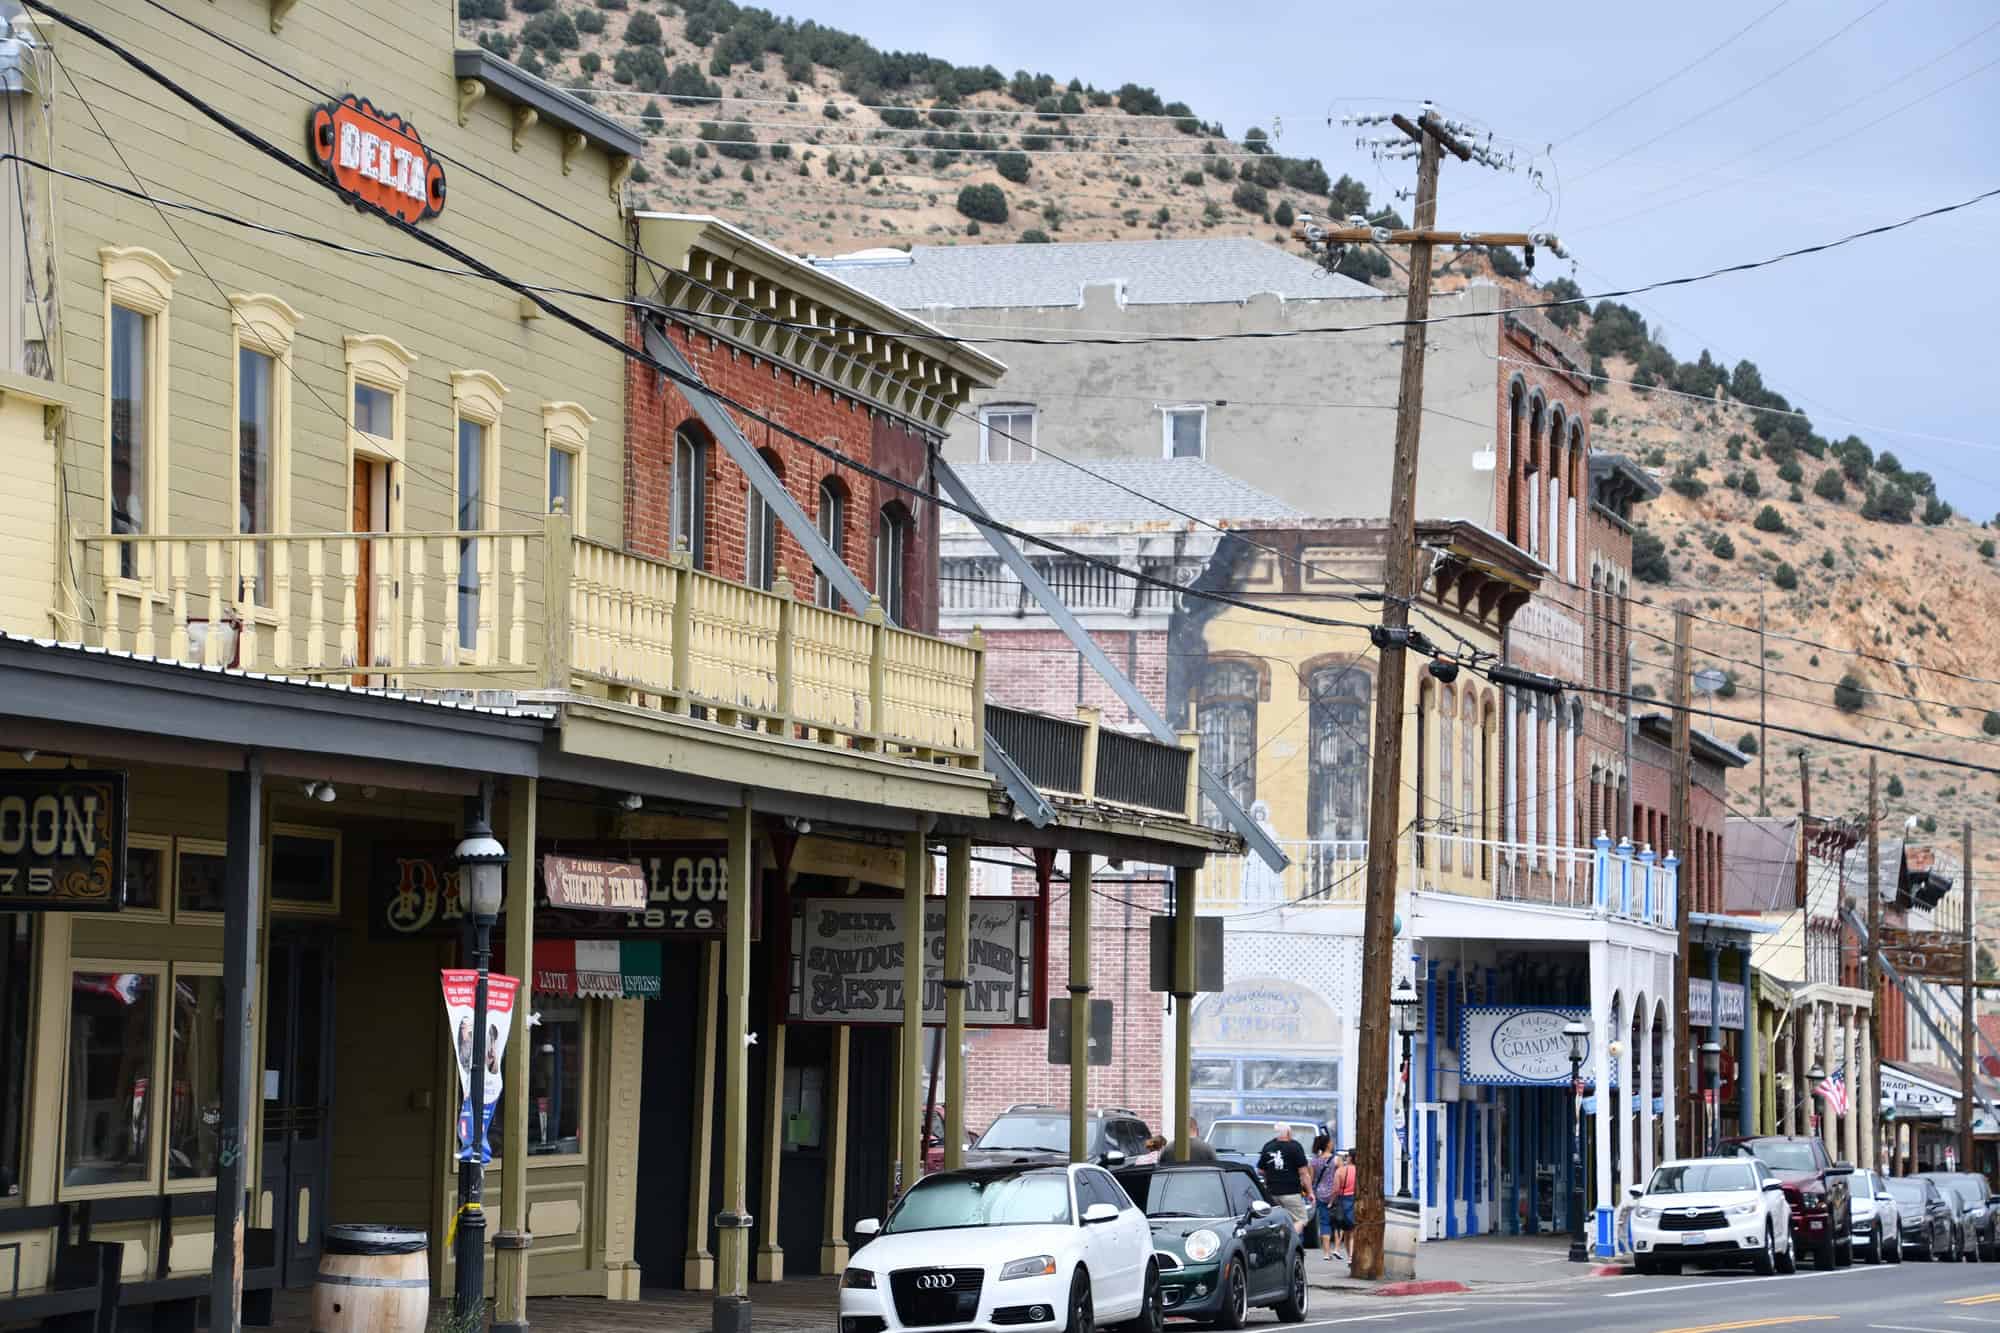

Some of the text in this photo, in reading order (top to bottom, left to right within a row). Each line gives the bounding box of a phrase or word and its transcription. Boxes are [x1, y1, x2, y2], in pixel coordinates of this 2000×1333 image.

[340, 121, 426, 201] DELTA
[571, 859, 602, 873] FAMOUS
[561, 873, 606, 906] SUICIDE
[627, 908, 713, 928] 1876
[817, 909, 896, 938] DELTA
[808, 940, 927, 975] SAWDUS
[539, 971, 569, 989] LATTE
